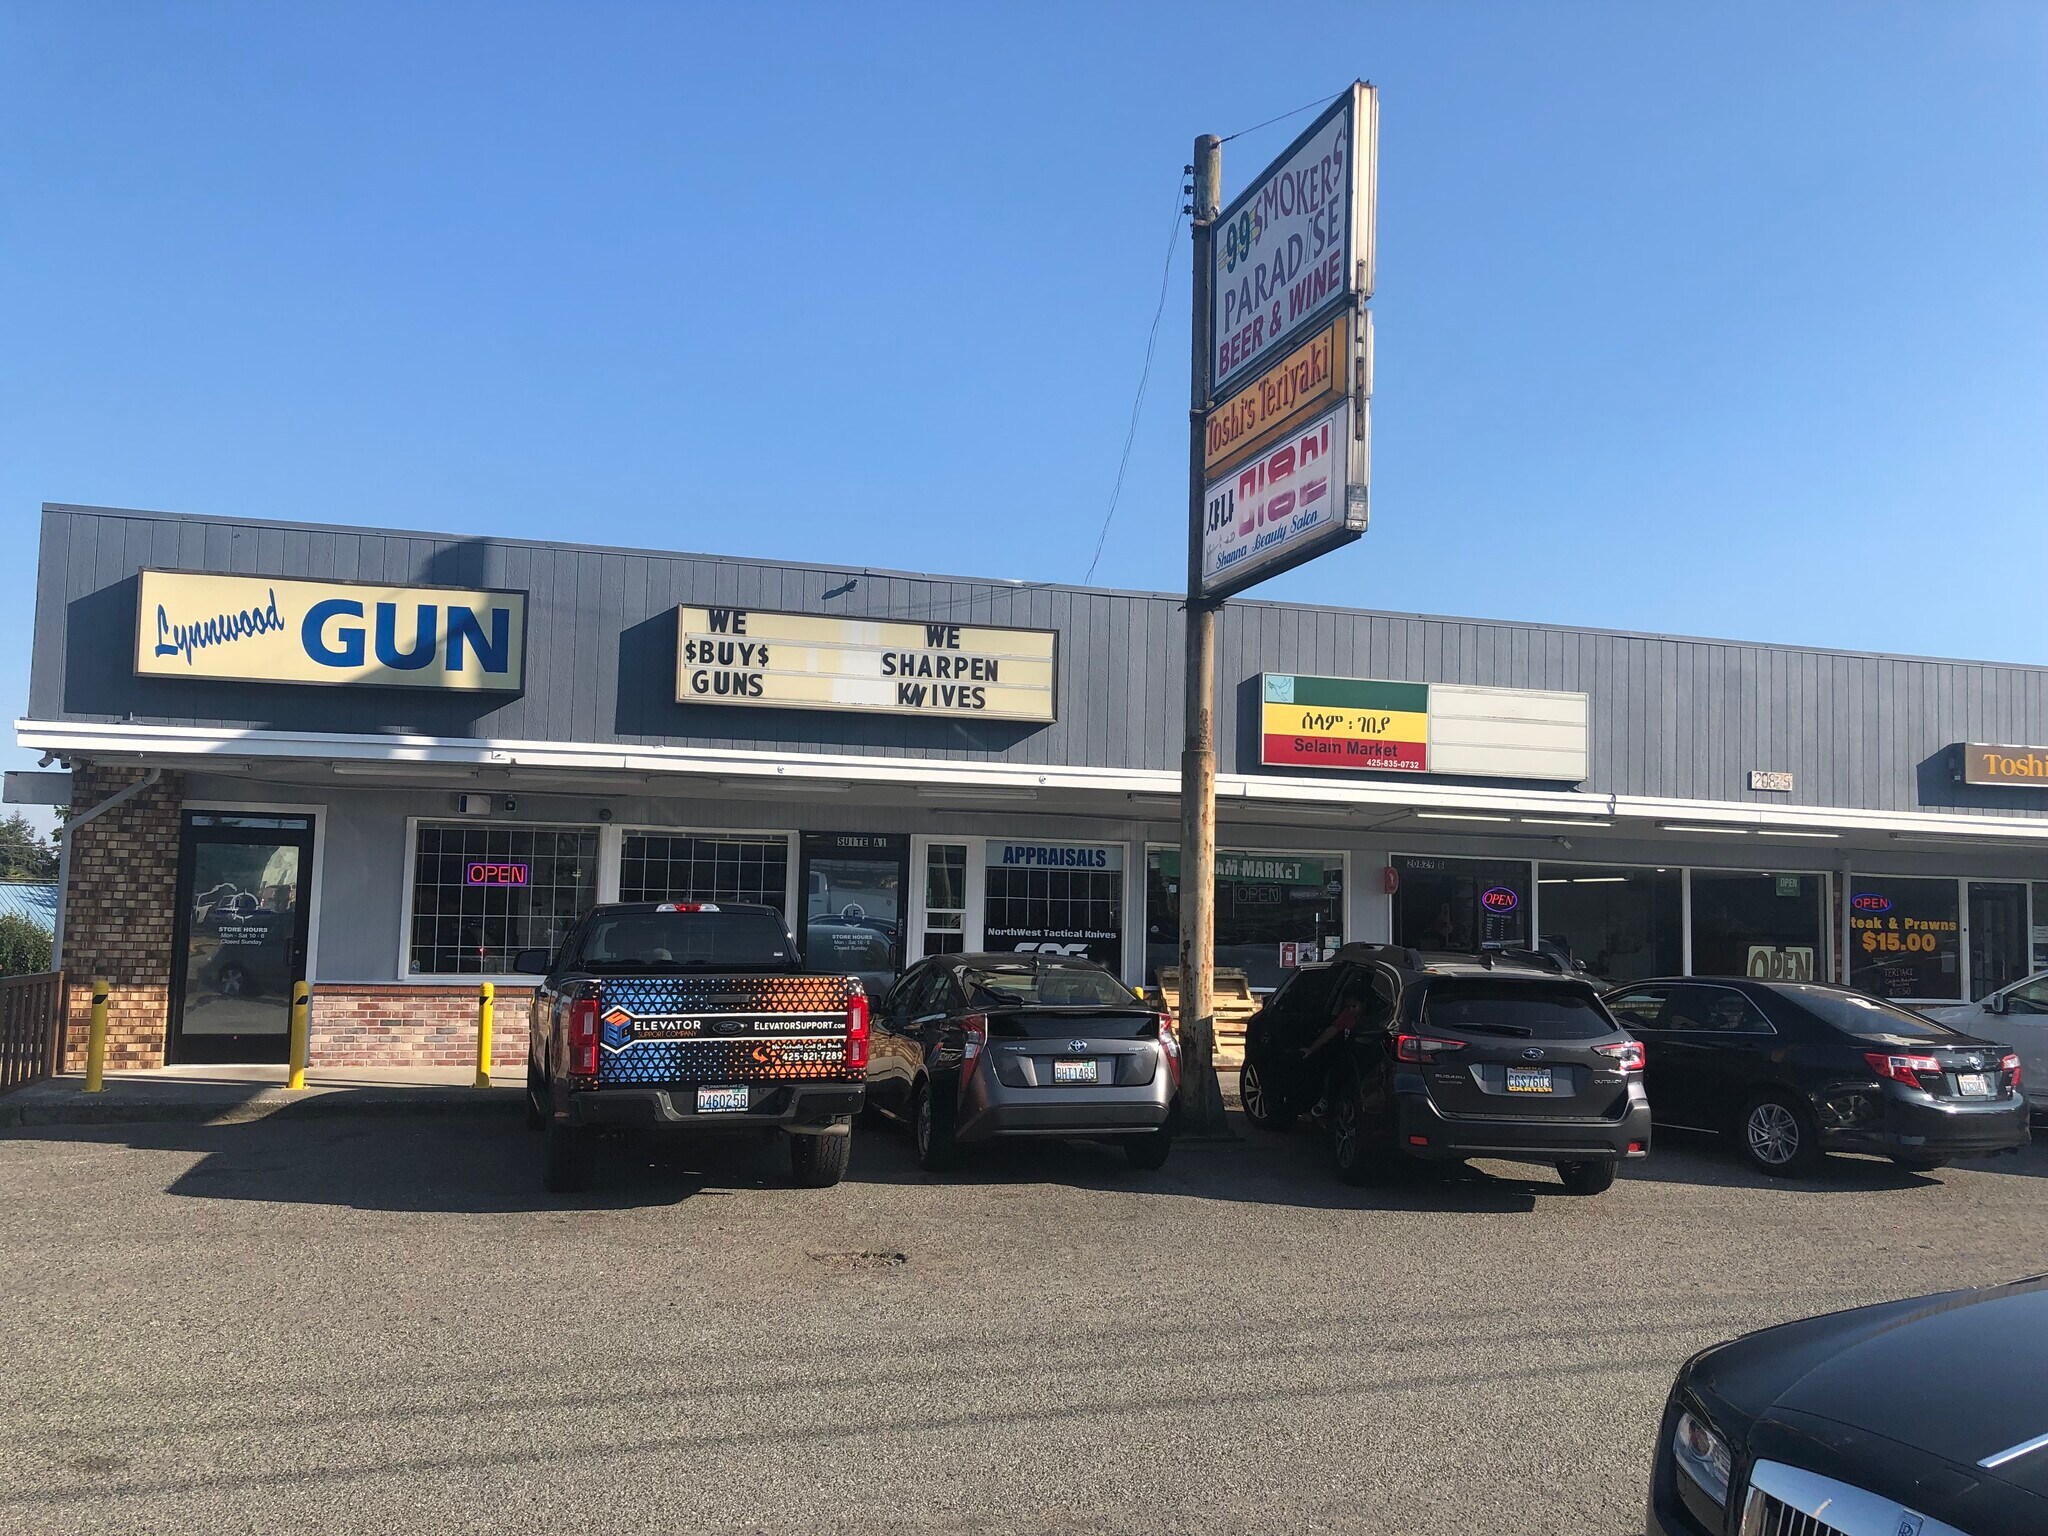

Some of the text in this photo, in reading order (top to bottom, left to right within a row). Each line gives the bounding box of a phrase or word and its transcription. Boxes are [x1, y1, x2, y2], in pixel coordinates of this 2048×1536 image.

[1226, 210, 1250, 274] 99
[1224, 193, 1340, 335] PARADISE
[1218, 249, 1341, 378] BEER & WINE
[1206, 336, 1329, 457] Toshi's Teriyaki
[1216, 544, 1248, 569] Shanna
[1252, 523, 1288, 552] Beauty
[1290, 508, 1319, 534] Salon
[154, 588, 510, 674] Lynnwood GUN
[708, 609, 747, 635] WE
[926, 626, 960, 649] WE
[685, 640, 769, 667] $BUY$
[882, 652, 999, 682] SHARPEN
[691, 670, 763, 697] GUNS
[1294, 738, 1398, 757] Selam Market
[1366, 758, 1419, 769] 425-835-0732
[838, 837, 868, 847] SUITE
[1003, 845, 1106, 868] APPRAISALS
[469, 865, 526, 884] OPEN
[1237, 887, 1279, 902] OPEN
[1485, 893, 1514, 906] OPEN
[1854, 897, 1889, 909] OPEN
[987, 927, 1117, 939] NorthWest Tactical Knives
[1850, 917, 1957, 931] teak & Prawns
[1862, 930, 1937, 953] $15.00
[1750, 950, 1811, 981] OPEN
[634, 1021, 701, 1031] ELEVATOR
[665, 1030, 698, 1038] COMPANY
[782, 1051, 843, 1061] 425-821-7289
